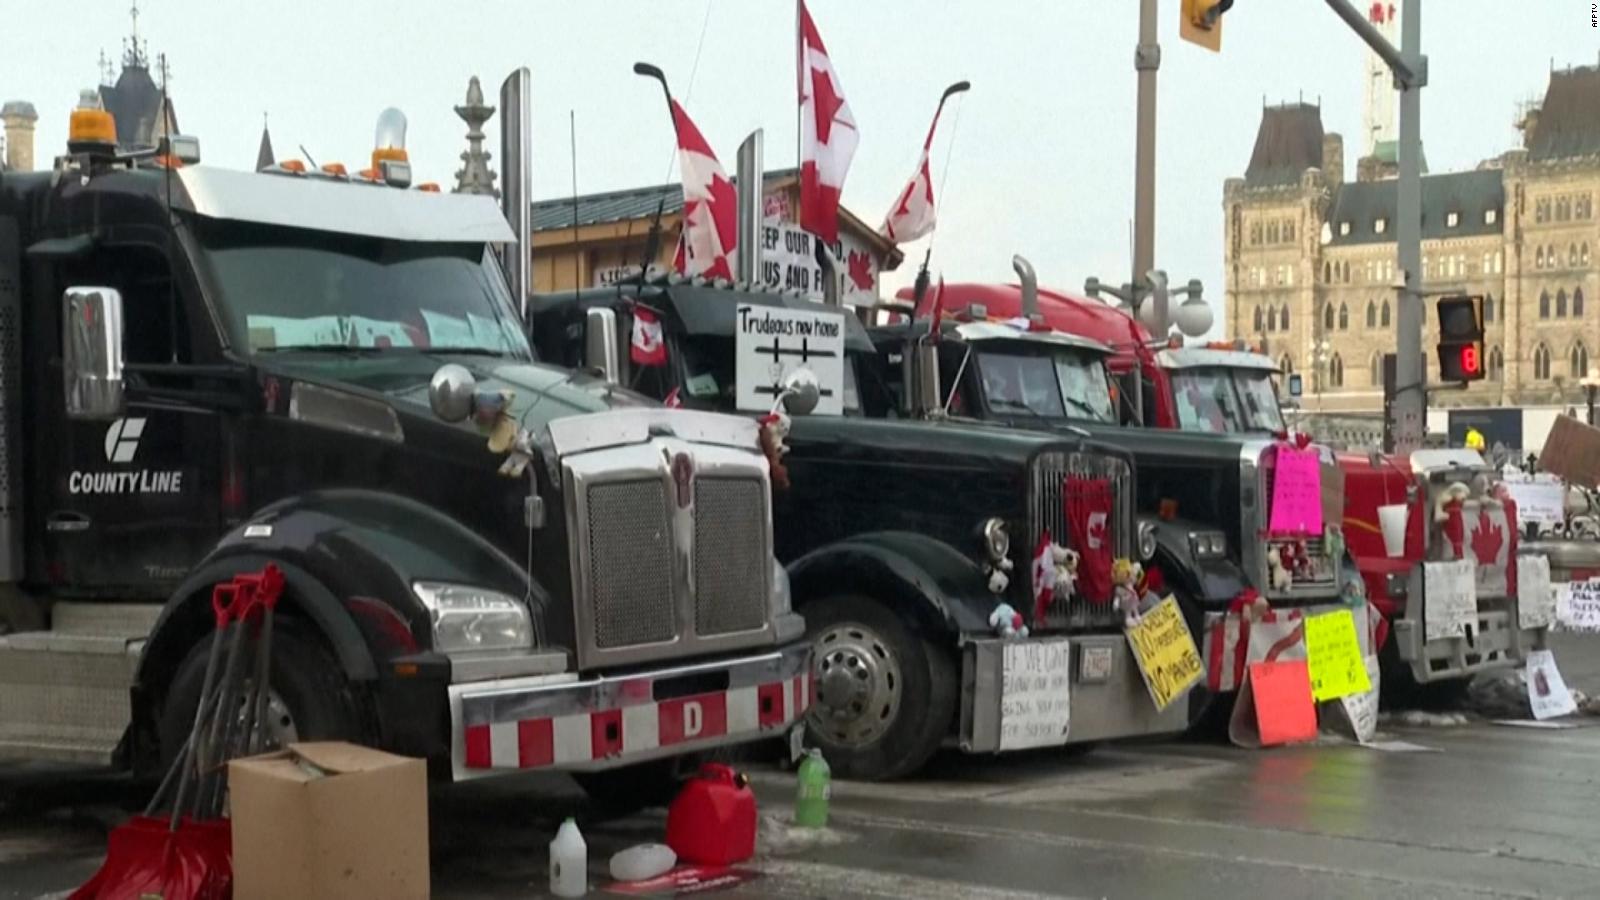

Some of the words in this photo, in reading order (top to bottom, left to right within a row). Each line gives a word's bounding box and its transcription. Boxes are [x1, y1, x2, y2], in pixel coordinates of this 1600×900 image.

[785, 230, 810, 256] OUR
[785, 264, 809, 290] AND
[814, 317, 839, 337] home
[1462, 345, 1479, 373] 8
[683, 701, 702, 736] D
